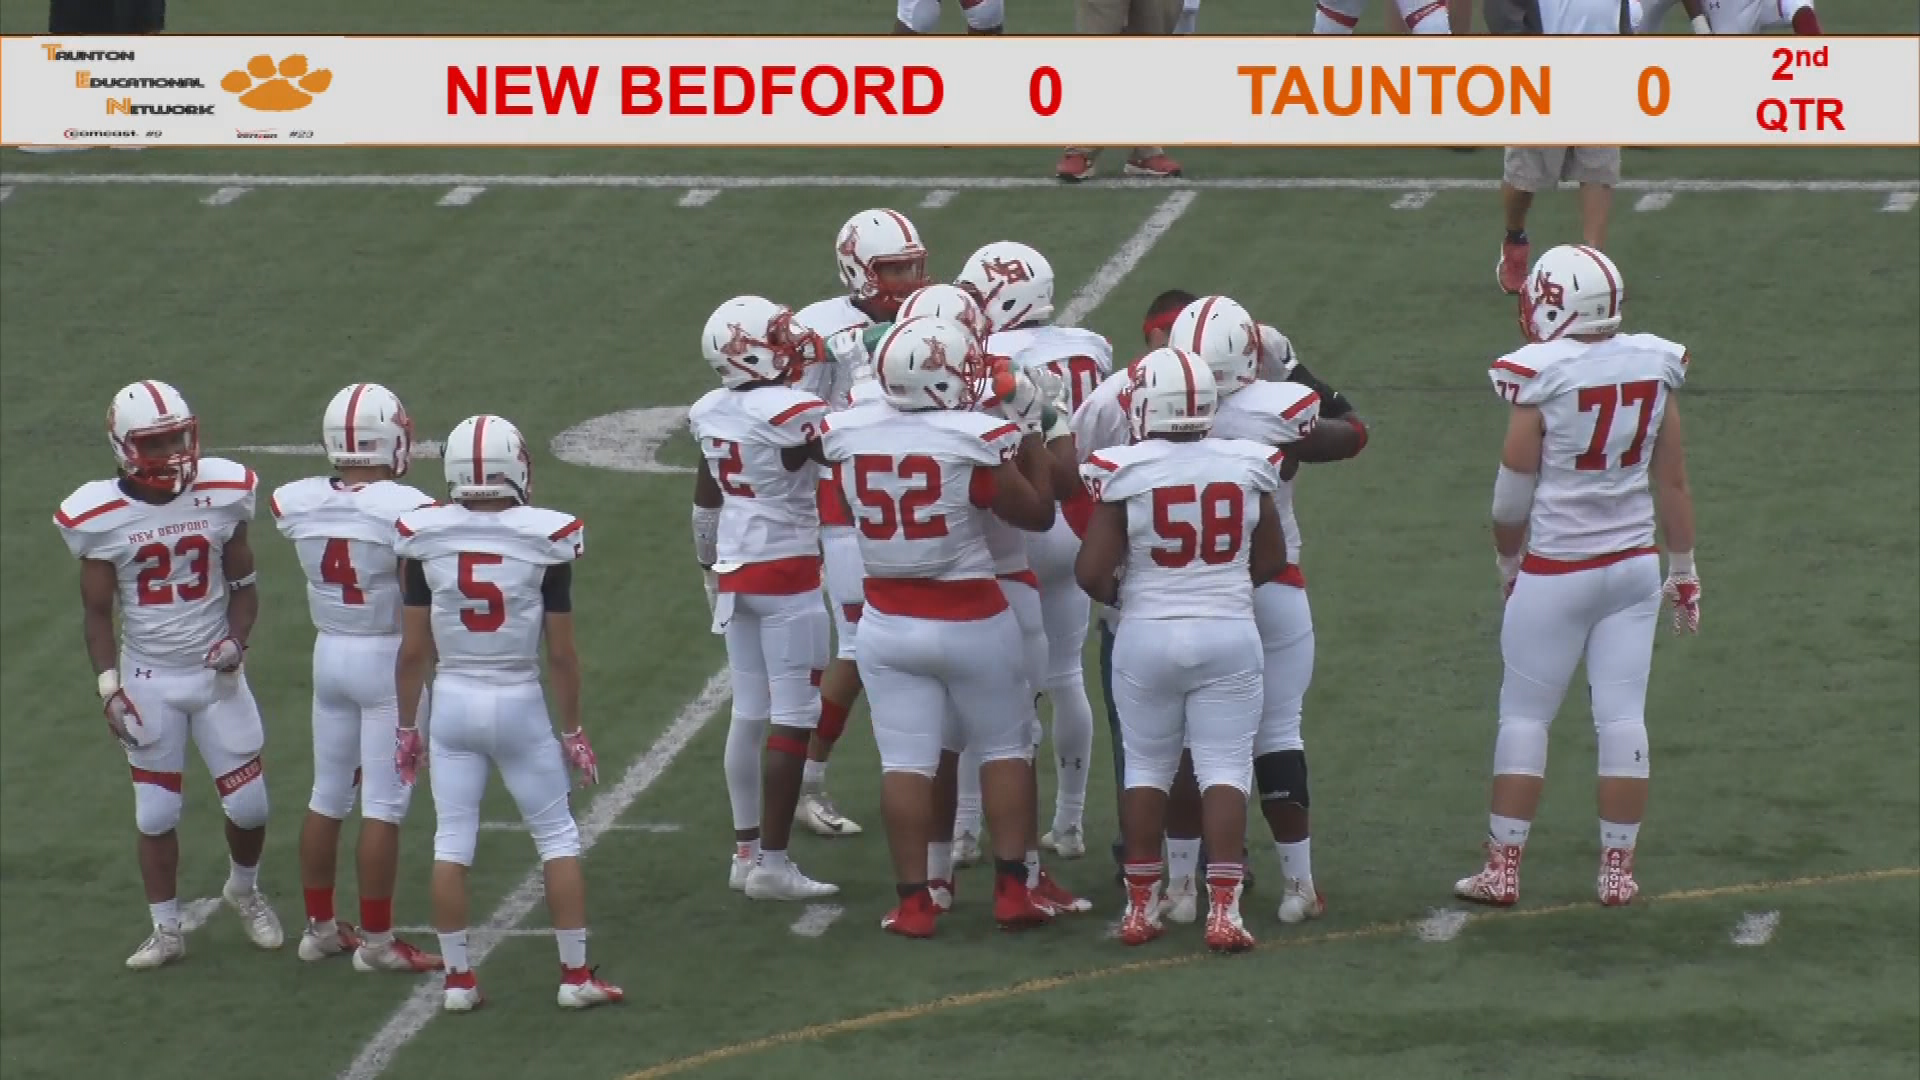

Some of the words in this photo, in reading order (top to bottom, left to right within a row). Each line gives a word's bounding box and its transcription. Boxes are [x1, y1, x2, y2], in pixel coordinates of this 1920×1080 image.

[1497, 380, 1520, 404] 77
[1576, 379, 1660, 471] 77
[711, 438, 756, 498] 2
[854, 454, 949, 541] 52
[128, 529, 154, 545] NEW
[158, 520, 209, 537] BEDFORD
[1151, 482, 1245, 568] 58
[134, 534, 210, 606] 23
[321, 538, 365, 604] 4
[458, 551, 506, 633] 5
[1507, 850, 1518, 894] UNDER
[1609, 851, 1622, 897] ARMOUR
